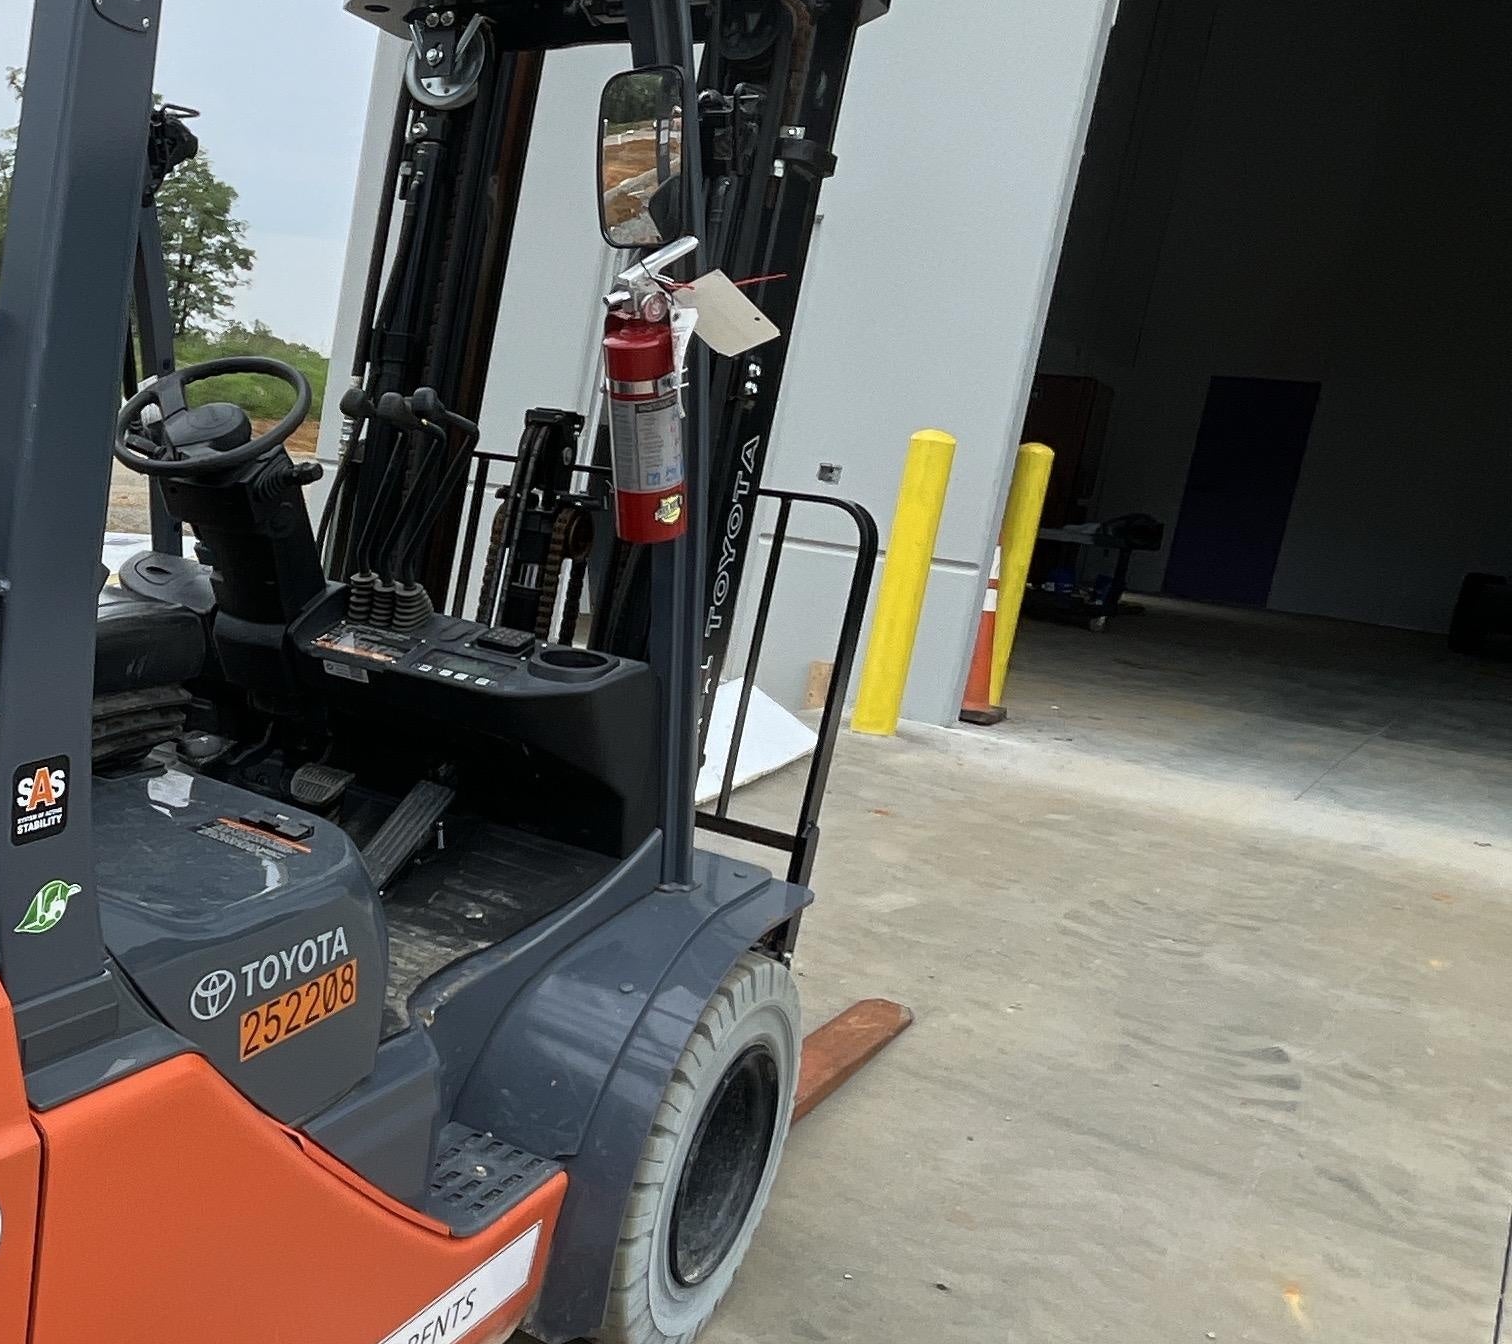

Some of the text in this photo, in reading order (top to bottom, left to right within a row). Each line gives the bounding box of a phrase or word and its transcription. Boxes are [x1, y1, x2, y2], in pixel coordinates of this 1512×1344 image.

[704, 435, 760, 638] TOYOTA
[16, 766, 66, 812] SAS
[16, 813, 63, 835] STABILITY
[241, 926, 349, 997] TOYOTA
[243, 963, 354, 1058] 252208
